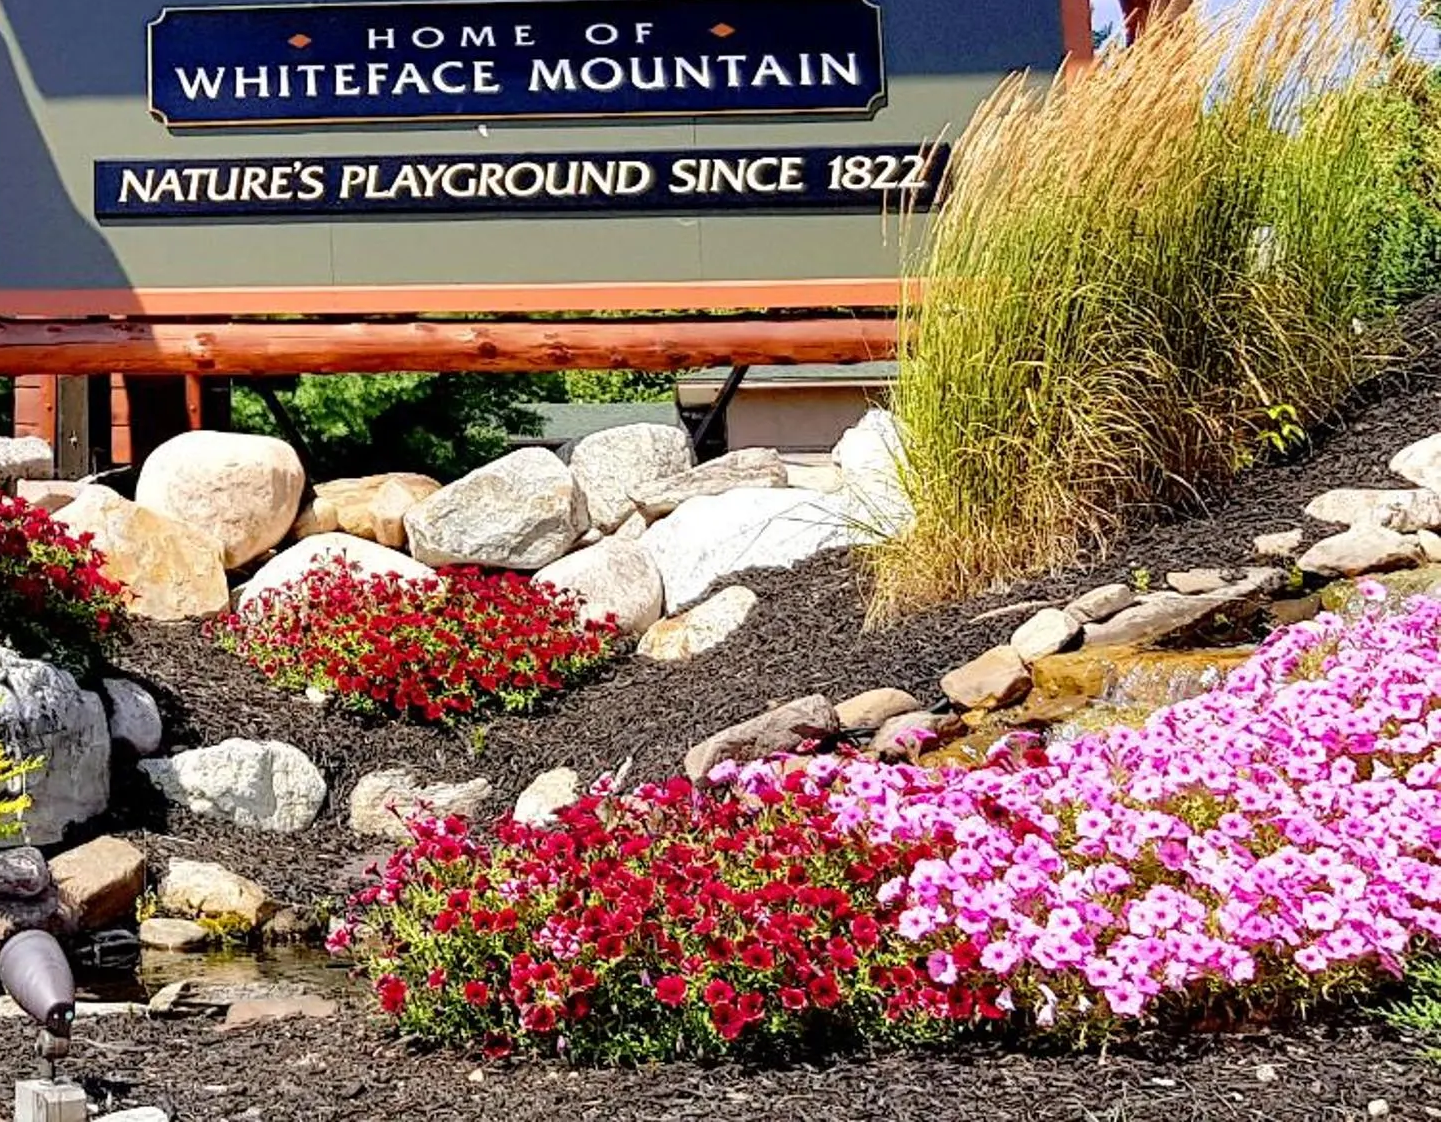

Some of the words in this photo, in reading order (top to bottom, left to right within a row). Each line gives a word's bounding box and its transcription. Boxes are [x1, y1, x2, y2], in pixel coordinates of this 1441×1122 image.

[367, 24, 536, 50] HOME
[584, 21, 654, 46] OF
[174, 60, 501, 101] WHITEFACE
[527, 52, 858, 93] MOUNTAIN
[117, 160, 325, 203] NATURE'S
[339, 156, 652, 198] PLAYGROUND
[668, 156, 804, 192] SINCE
[827, 154, 928, 190] 1822
